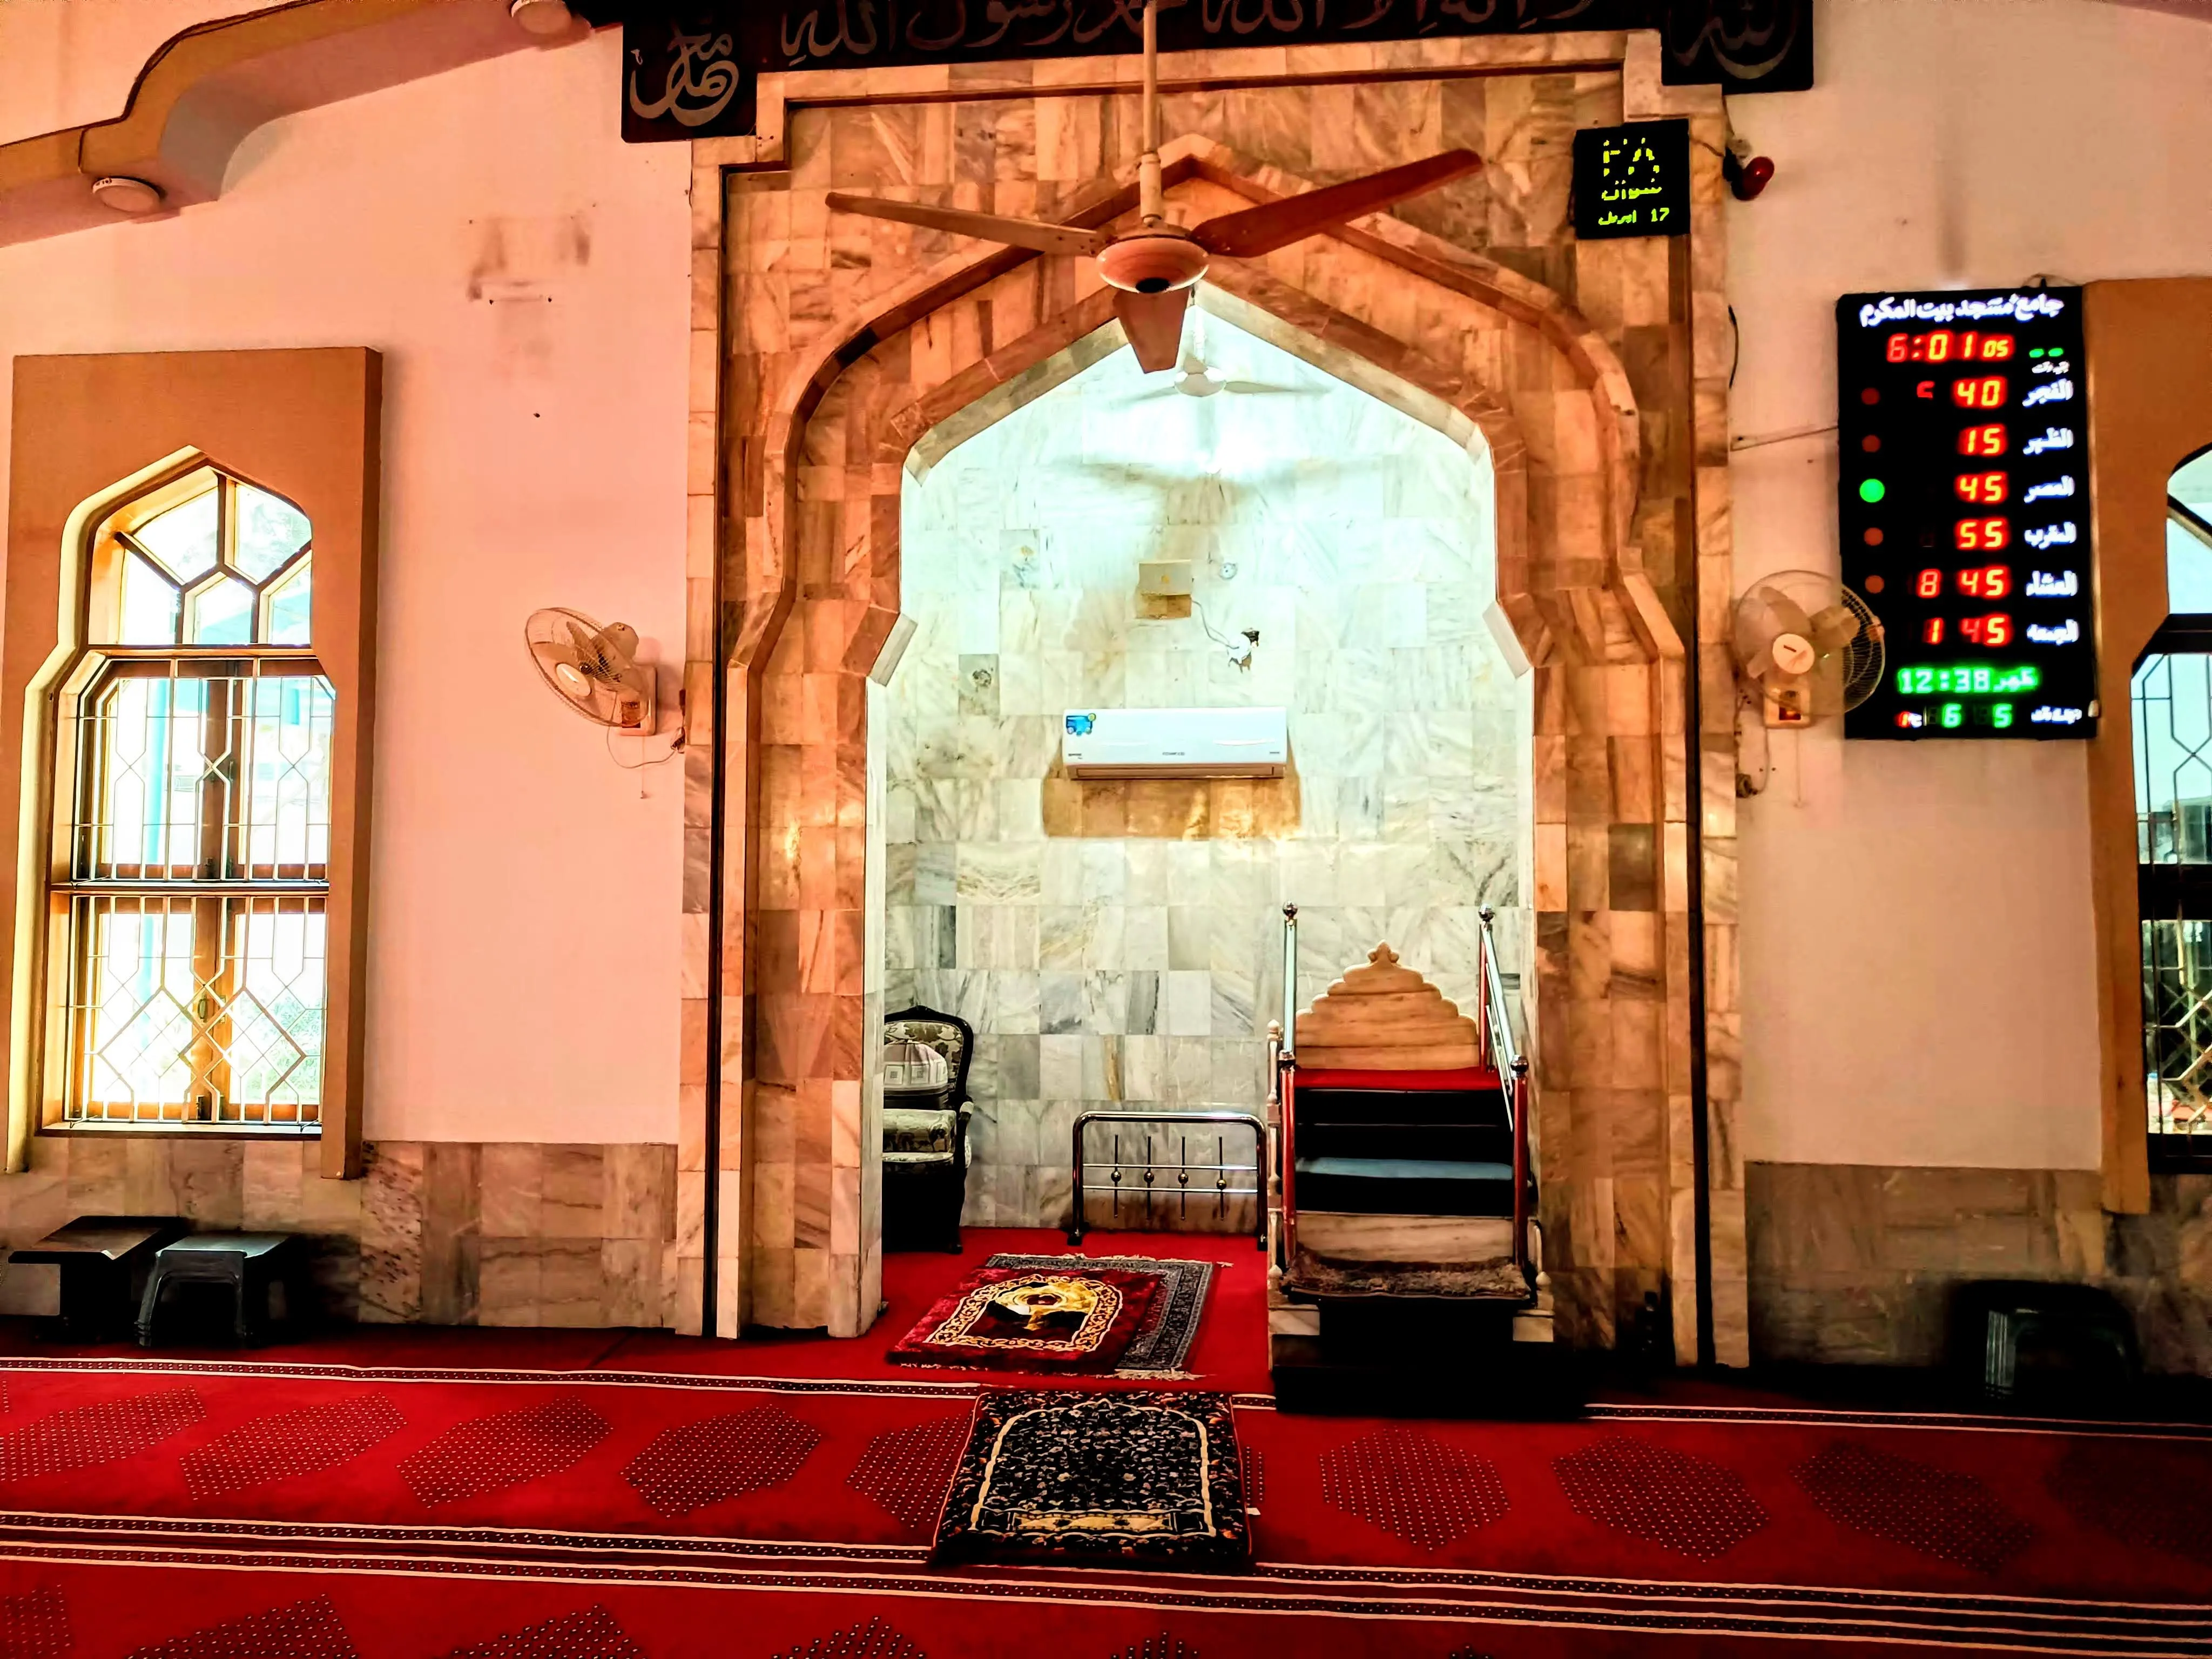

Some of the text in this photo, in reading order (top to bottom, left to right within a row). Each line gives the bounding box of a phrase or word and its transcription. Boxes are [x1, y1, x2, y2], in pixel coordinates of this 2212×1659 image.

[1651, 207, 1670, 222] 17
[1964, 426, 2003, 455] 15
[1957, 473, 2005, 503] 45
[1957, 519, 2006, 549] 55
[1919, 567, 2007, 598] 8 45
[1929, 616, 2007, 645] 1 45
[1898, 667, 1991, 693] 12:38
